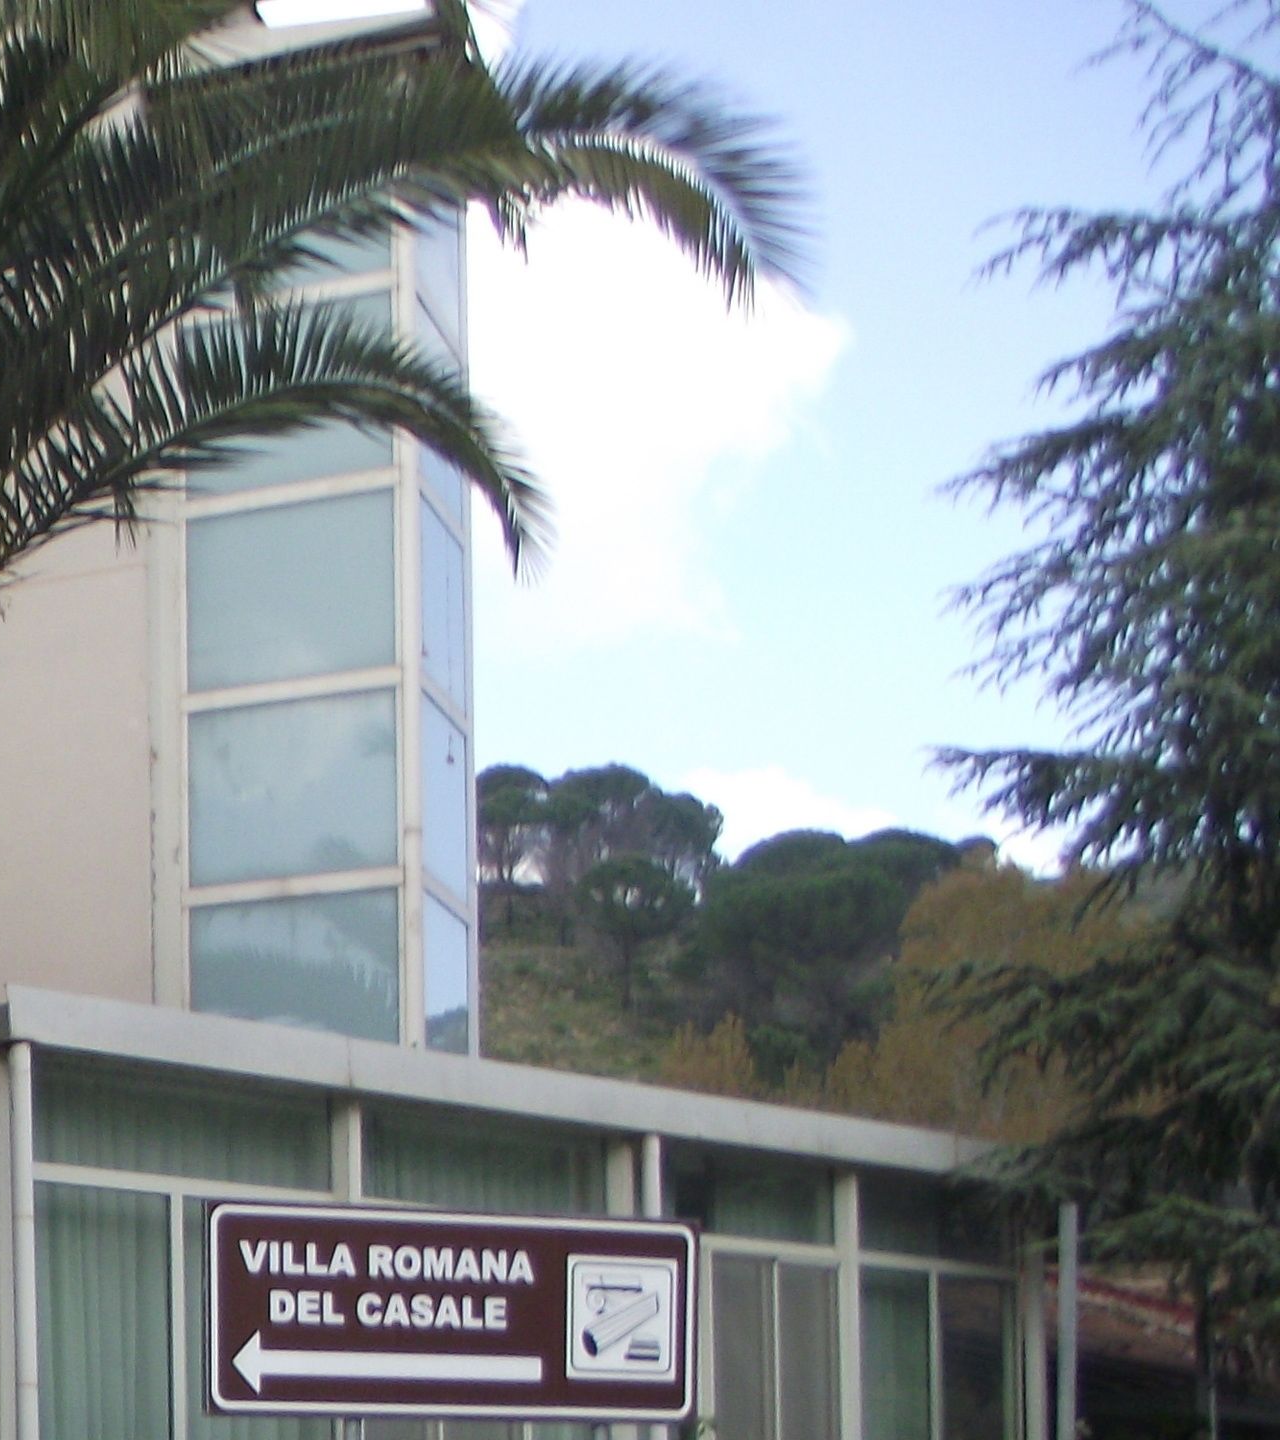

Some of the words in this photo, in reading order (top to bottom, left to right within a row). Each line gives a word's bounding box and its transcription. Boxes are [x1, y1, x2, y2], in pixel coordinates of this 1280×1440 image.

[238, 1239, 357, 1278] VILLA
[367, 1244, 535, 1285] ROMANA
[268, 1288, 345, 1327] DEL
[356, 1291, 509, 1331] CASALE
